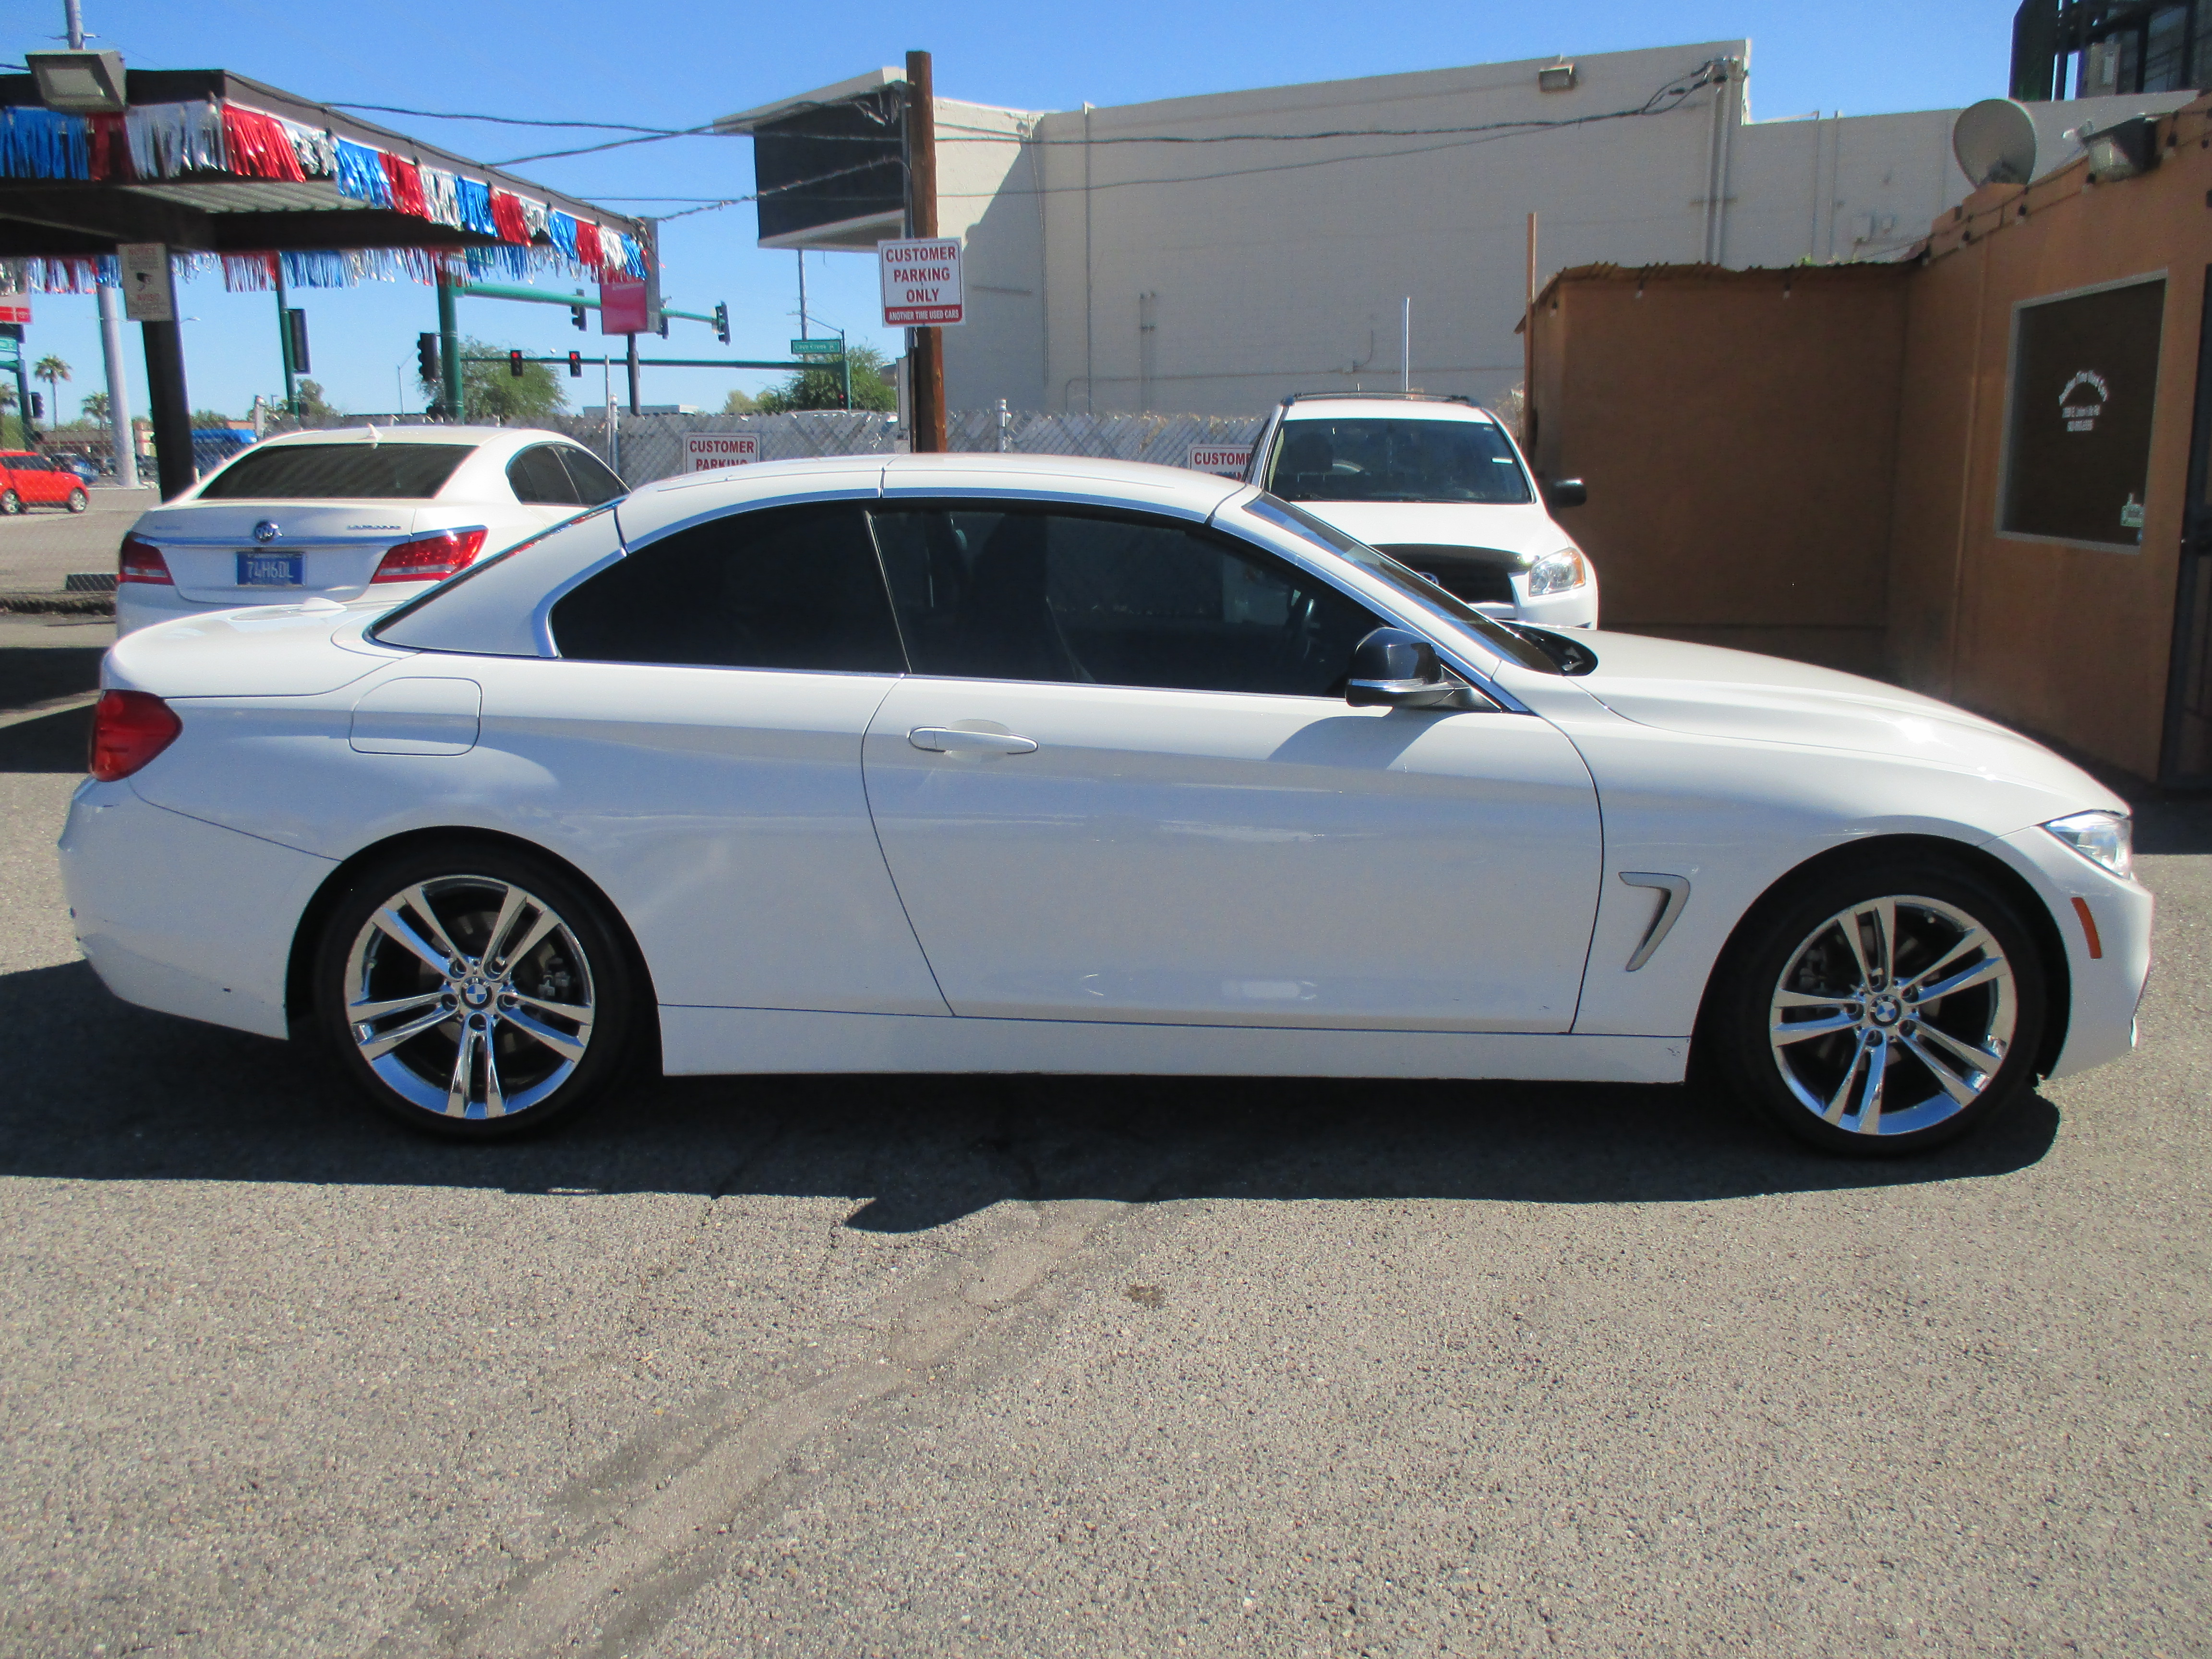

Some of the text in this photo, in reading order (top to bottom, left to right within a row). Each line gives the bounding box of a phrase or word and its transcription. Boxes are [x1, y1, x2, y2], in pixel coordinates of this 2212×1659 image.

[886, 246, 956, 263] CUSTOMER
[894, 267, 950, 283] PARKING
[906, 288, 939, 303] ONLY
[889, 309, 959, 321] ANOTHER TIME USED CARS
[690, 440, 754, 453] CUSTOMER
[1194, 452, 1251, 465] CUSTOM
